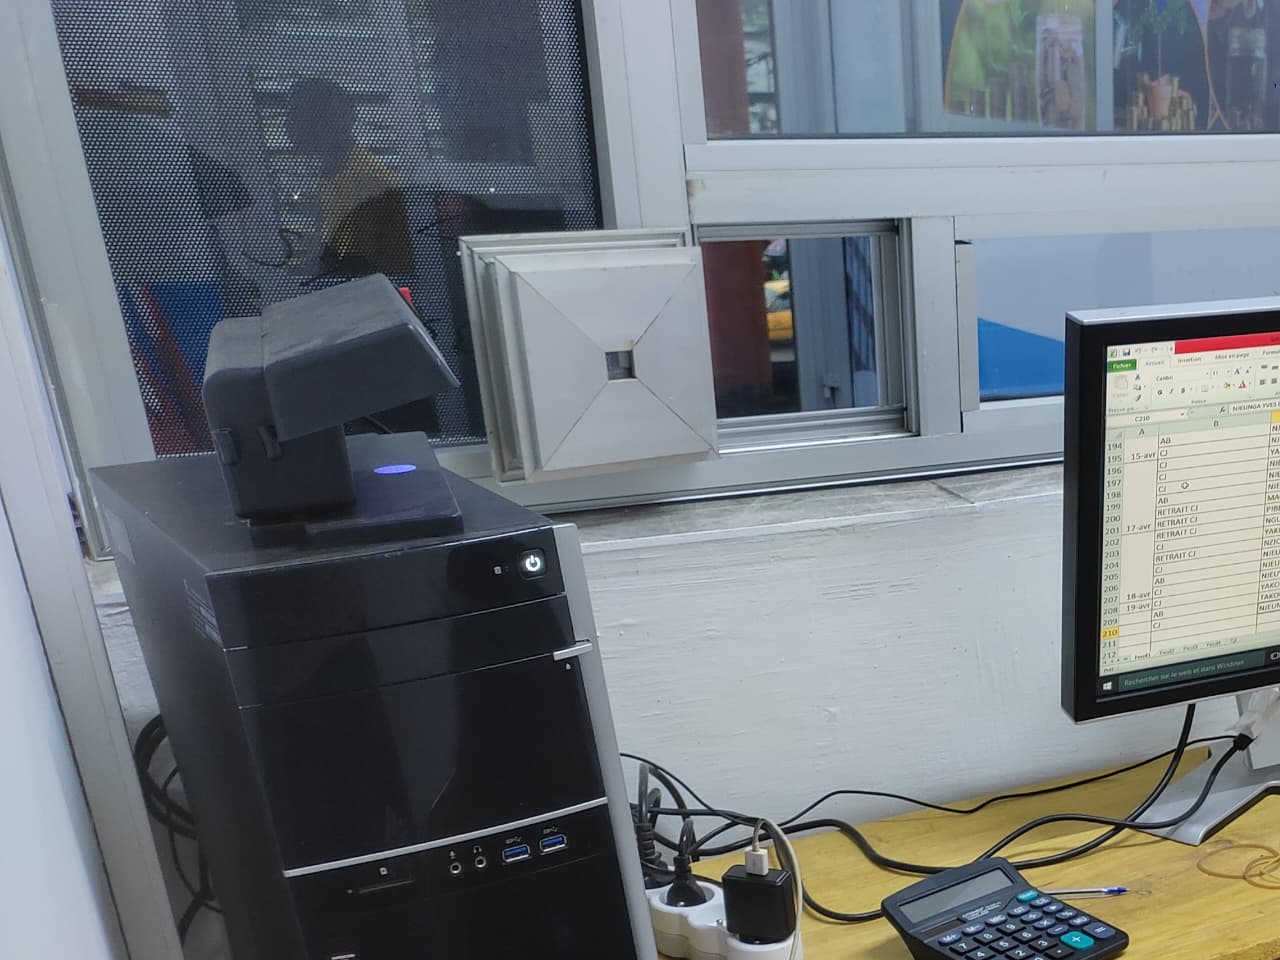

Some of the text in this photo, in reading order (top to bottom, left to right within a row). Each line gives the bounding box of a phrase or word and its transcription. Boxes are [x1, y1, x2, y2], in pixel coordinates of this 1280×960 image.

[1108, 443, 1122, 451] 194
[1108, 455, 1122, 463] 195
[1107, 467, 1122, 475] 196
[1158, 506, 1188, 515] RETRAIT
[1157, 518, 1187, 527] RETRAIT
[1156, 530, 1186, 539] RETRAIT
[1155, 553, 1187, 562] RETRAIT
